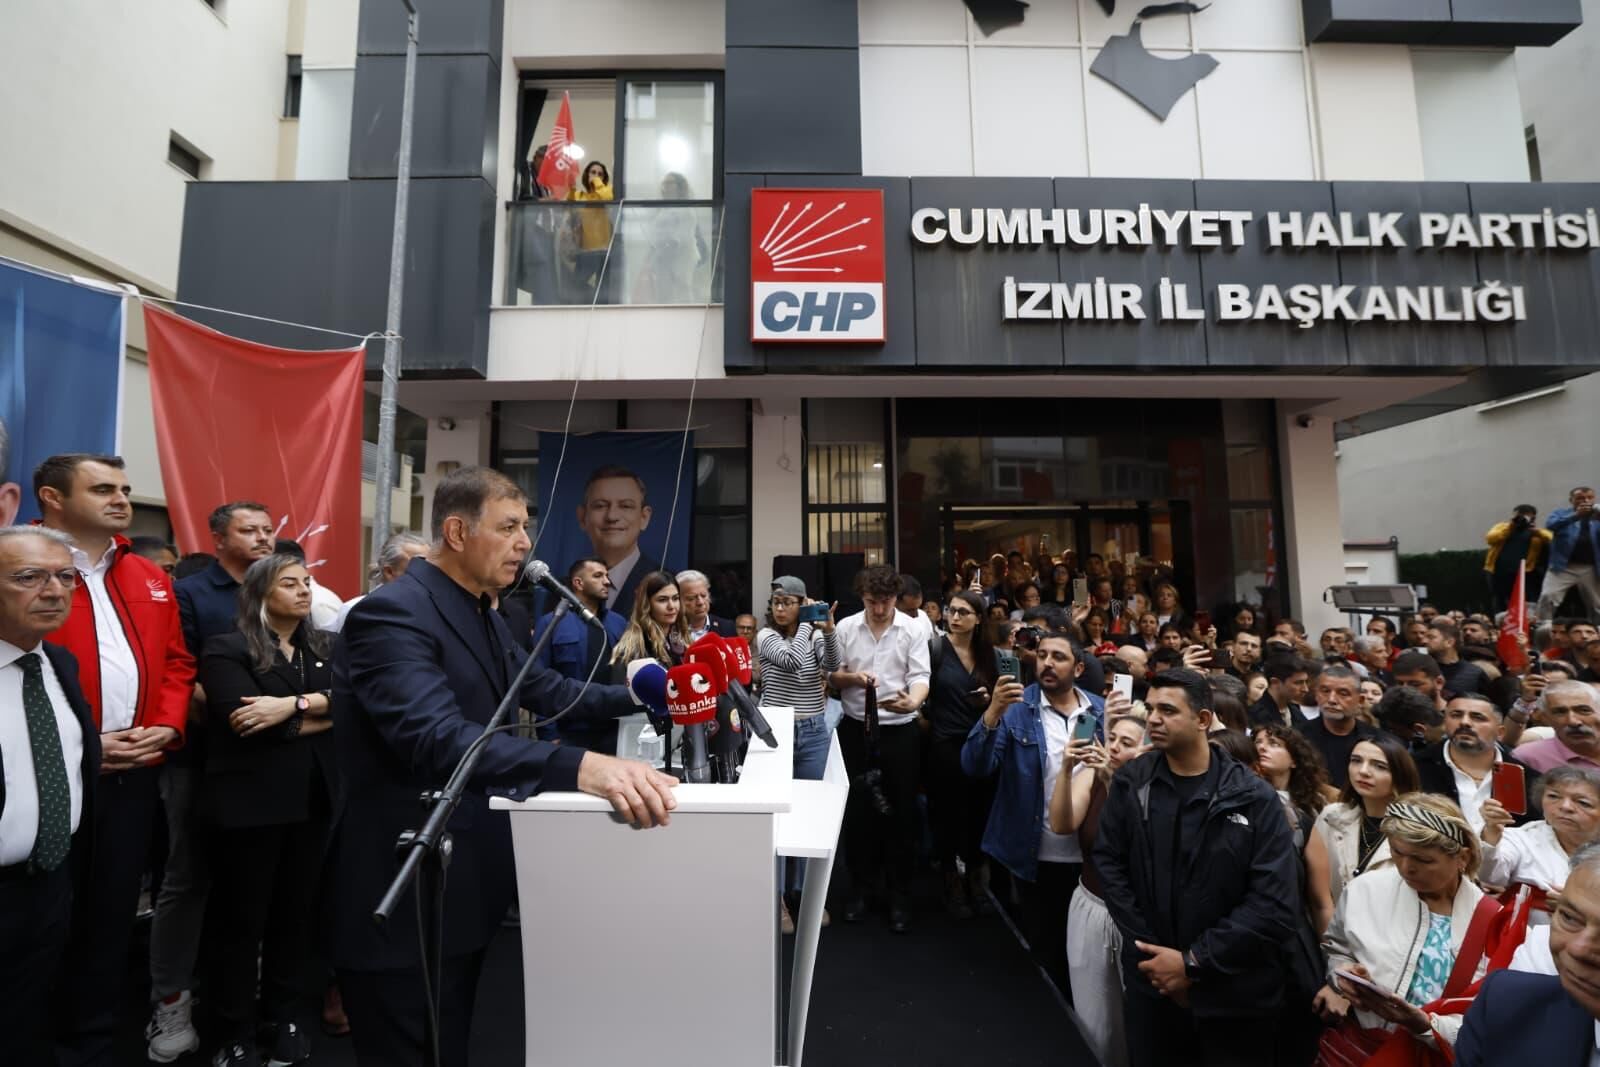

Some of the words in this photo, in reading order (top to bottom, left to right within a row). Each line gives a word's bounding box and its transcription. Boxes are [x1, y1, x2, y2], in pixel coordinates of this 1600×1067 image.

[911, 203, 1253, 246] CUMHURİYET
[1267, 211, 1407, 247] HALK
[1419, 208, 1600, 248] PARTİSİ
[761, 291, 876, 332] CHP
[1003, 276, 1146, 320] İZMİR
[1158, 277, 1205, 320] İL
[1217, 280, 1527, 328] BAŞKANLIĞI
[689, 695, 717, 710] anka
